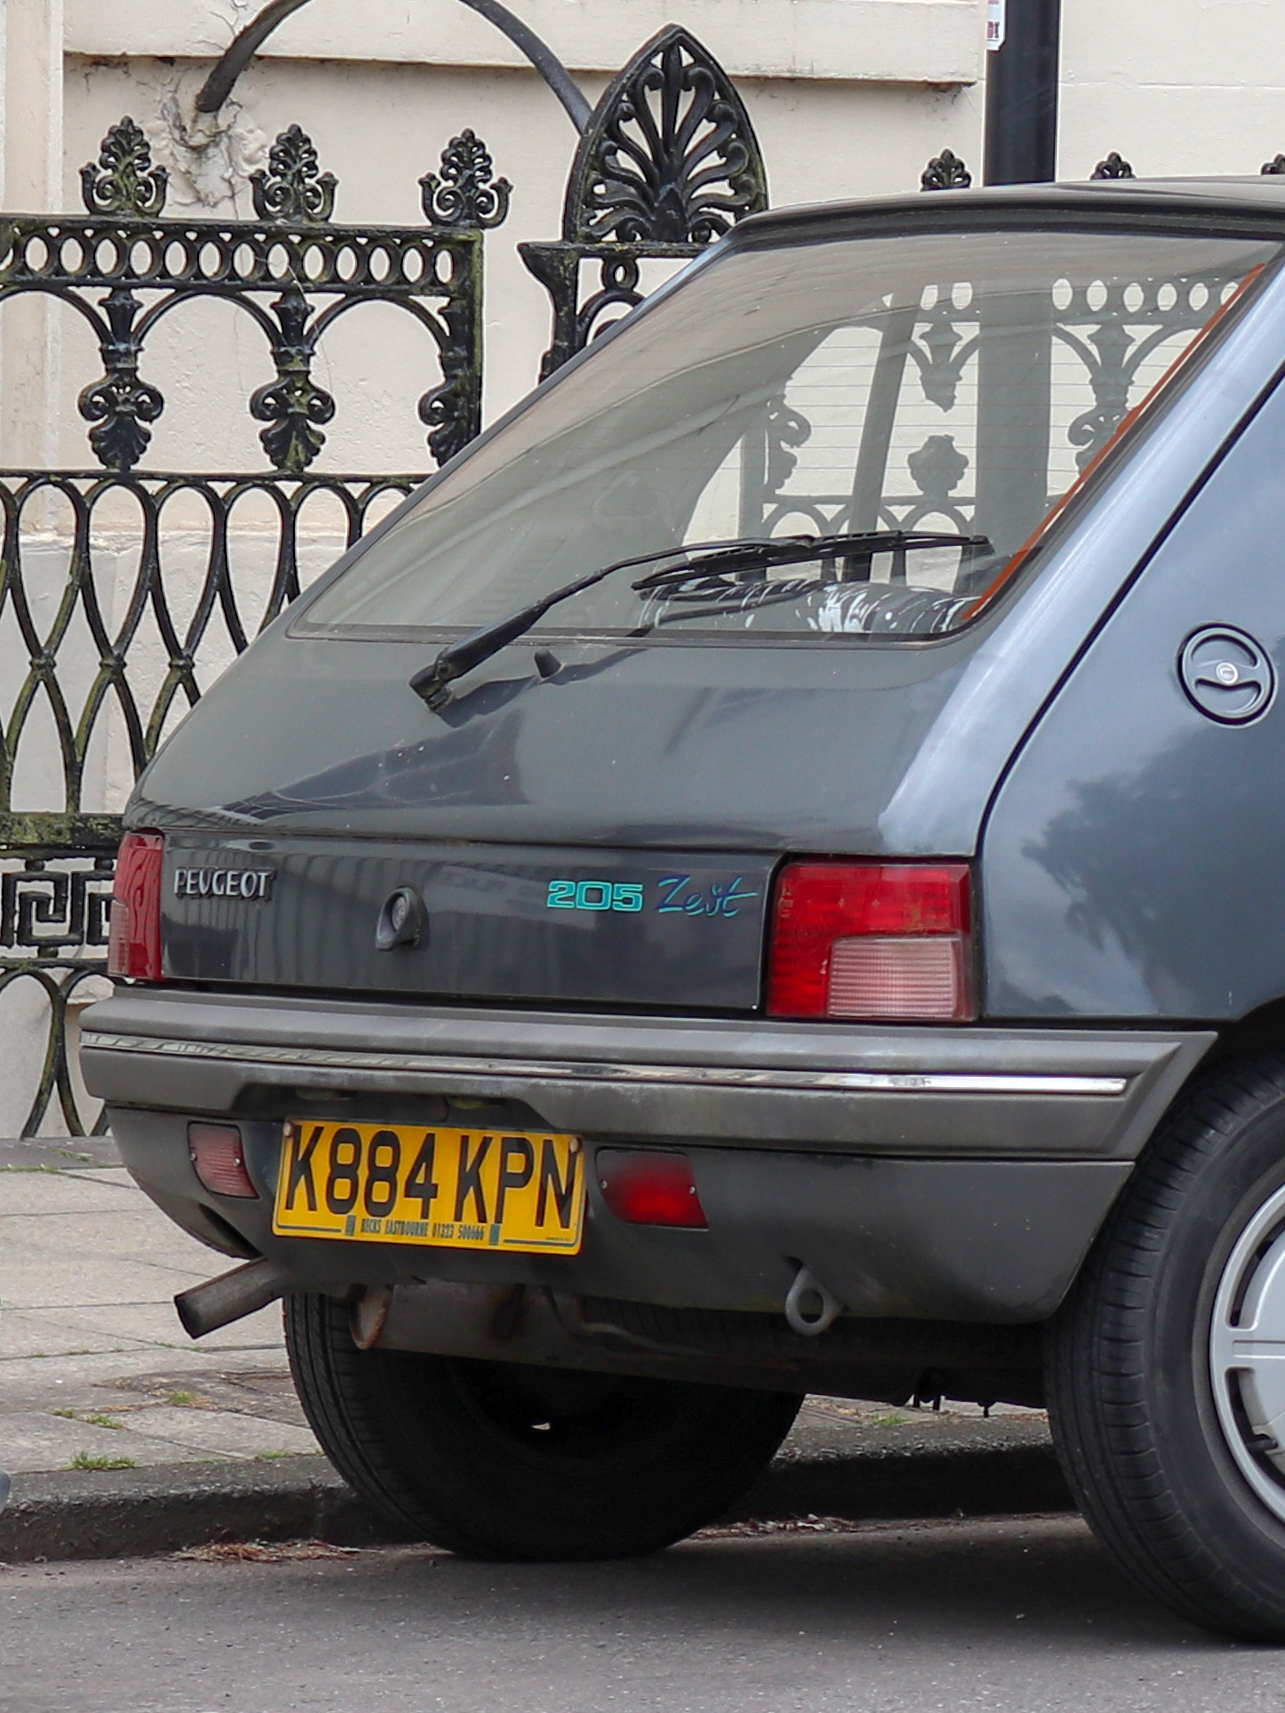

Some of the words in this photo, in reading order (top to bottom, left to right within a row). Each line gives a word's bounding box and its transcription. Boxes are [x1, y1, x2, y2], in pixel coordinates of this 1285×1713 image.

[173, 868, 273, 899] PEUGEOT
[546, 880, 644, 913] 205
[653, 874, 760, 917] Zest
[284, 1125, 439, 1219] K884
[453, 1135, 578, 1229] KPN
